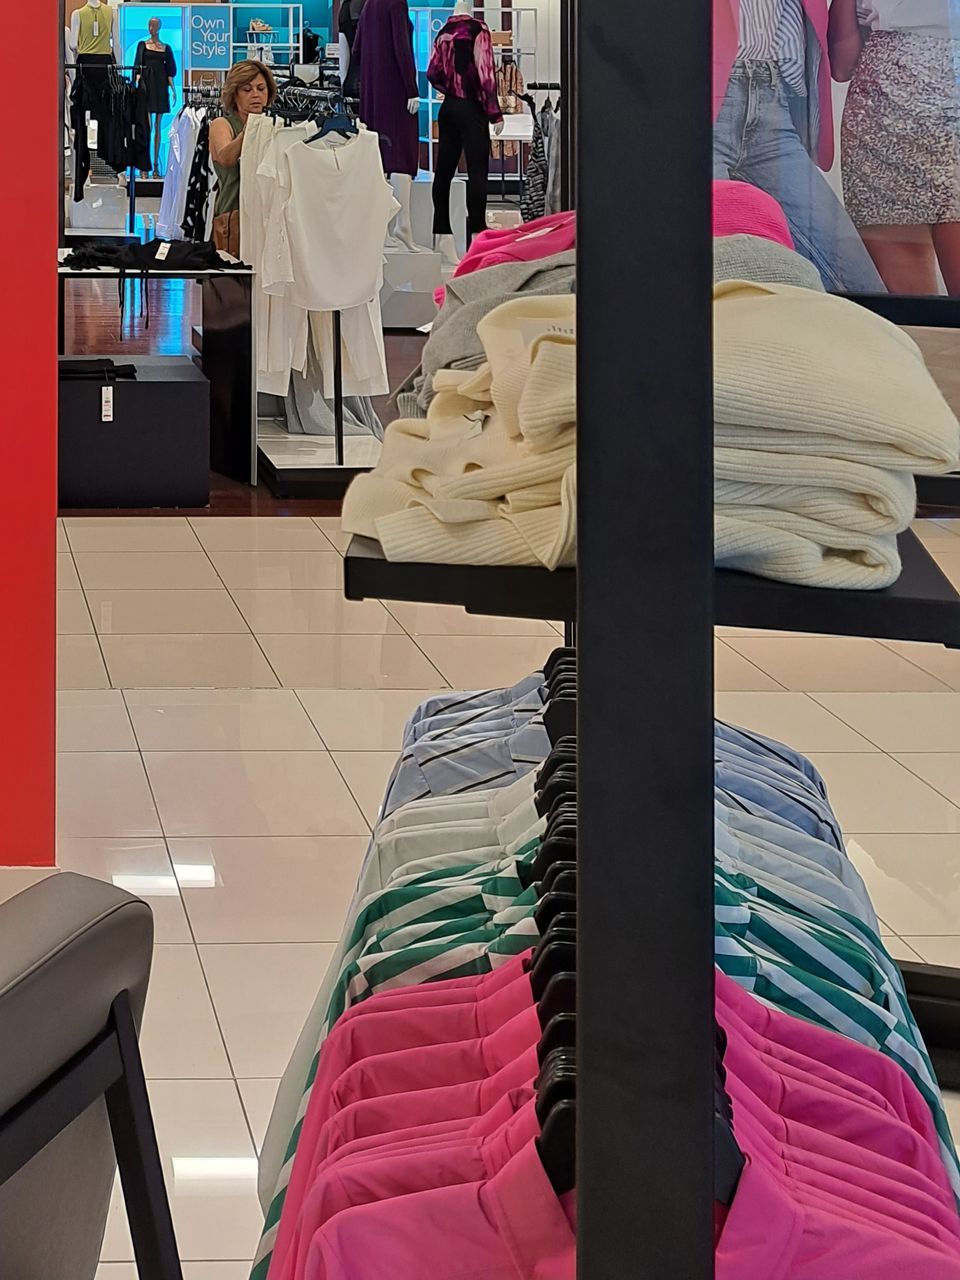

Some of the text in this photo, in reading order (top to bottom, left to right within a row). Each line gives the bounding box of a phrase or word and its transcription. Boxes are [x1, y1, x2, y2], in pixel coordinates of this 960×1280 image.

[191, 15, 225, 29] Own
[200, 28, 231, 42] Your
[191, 41, 226, 59] Style
